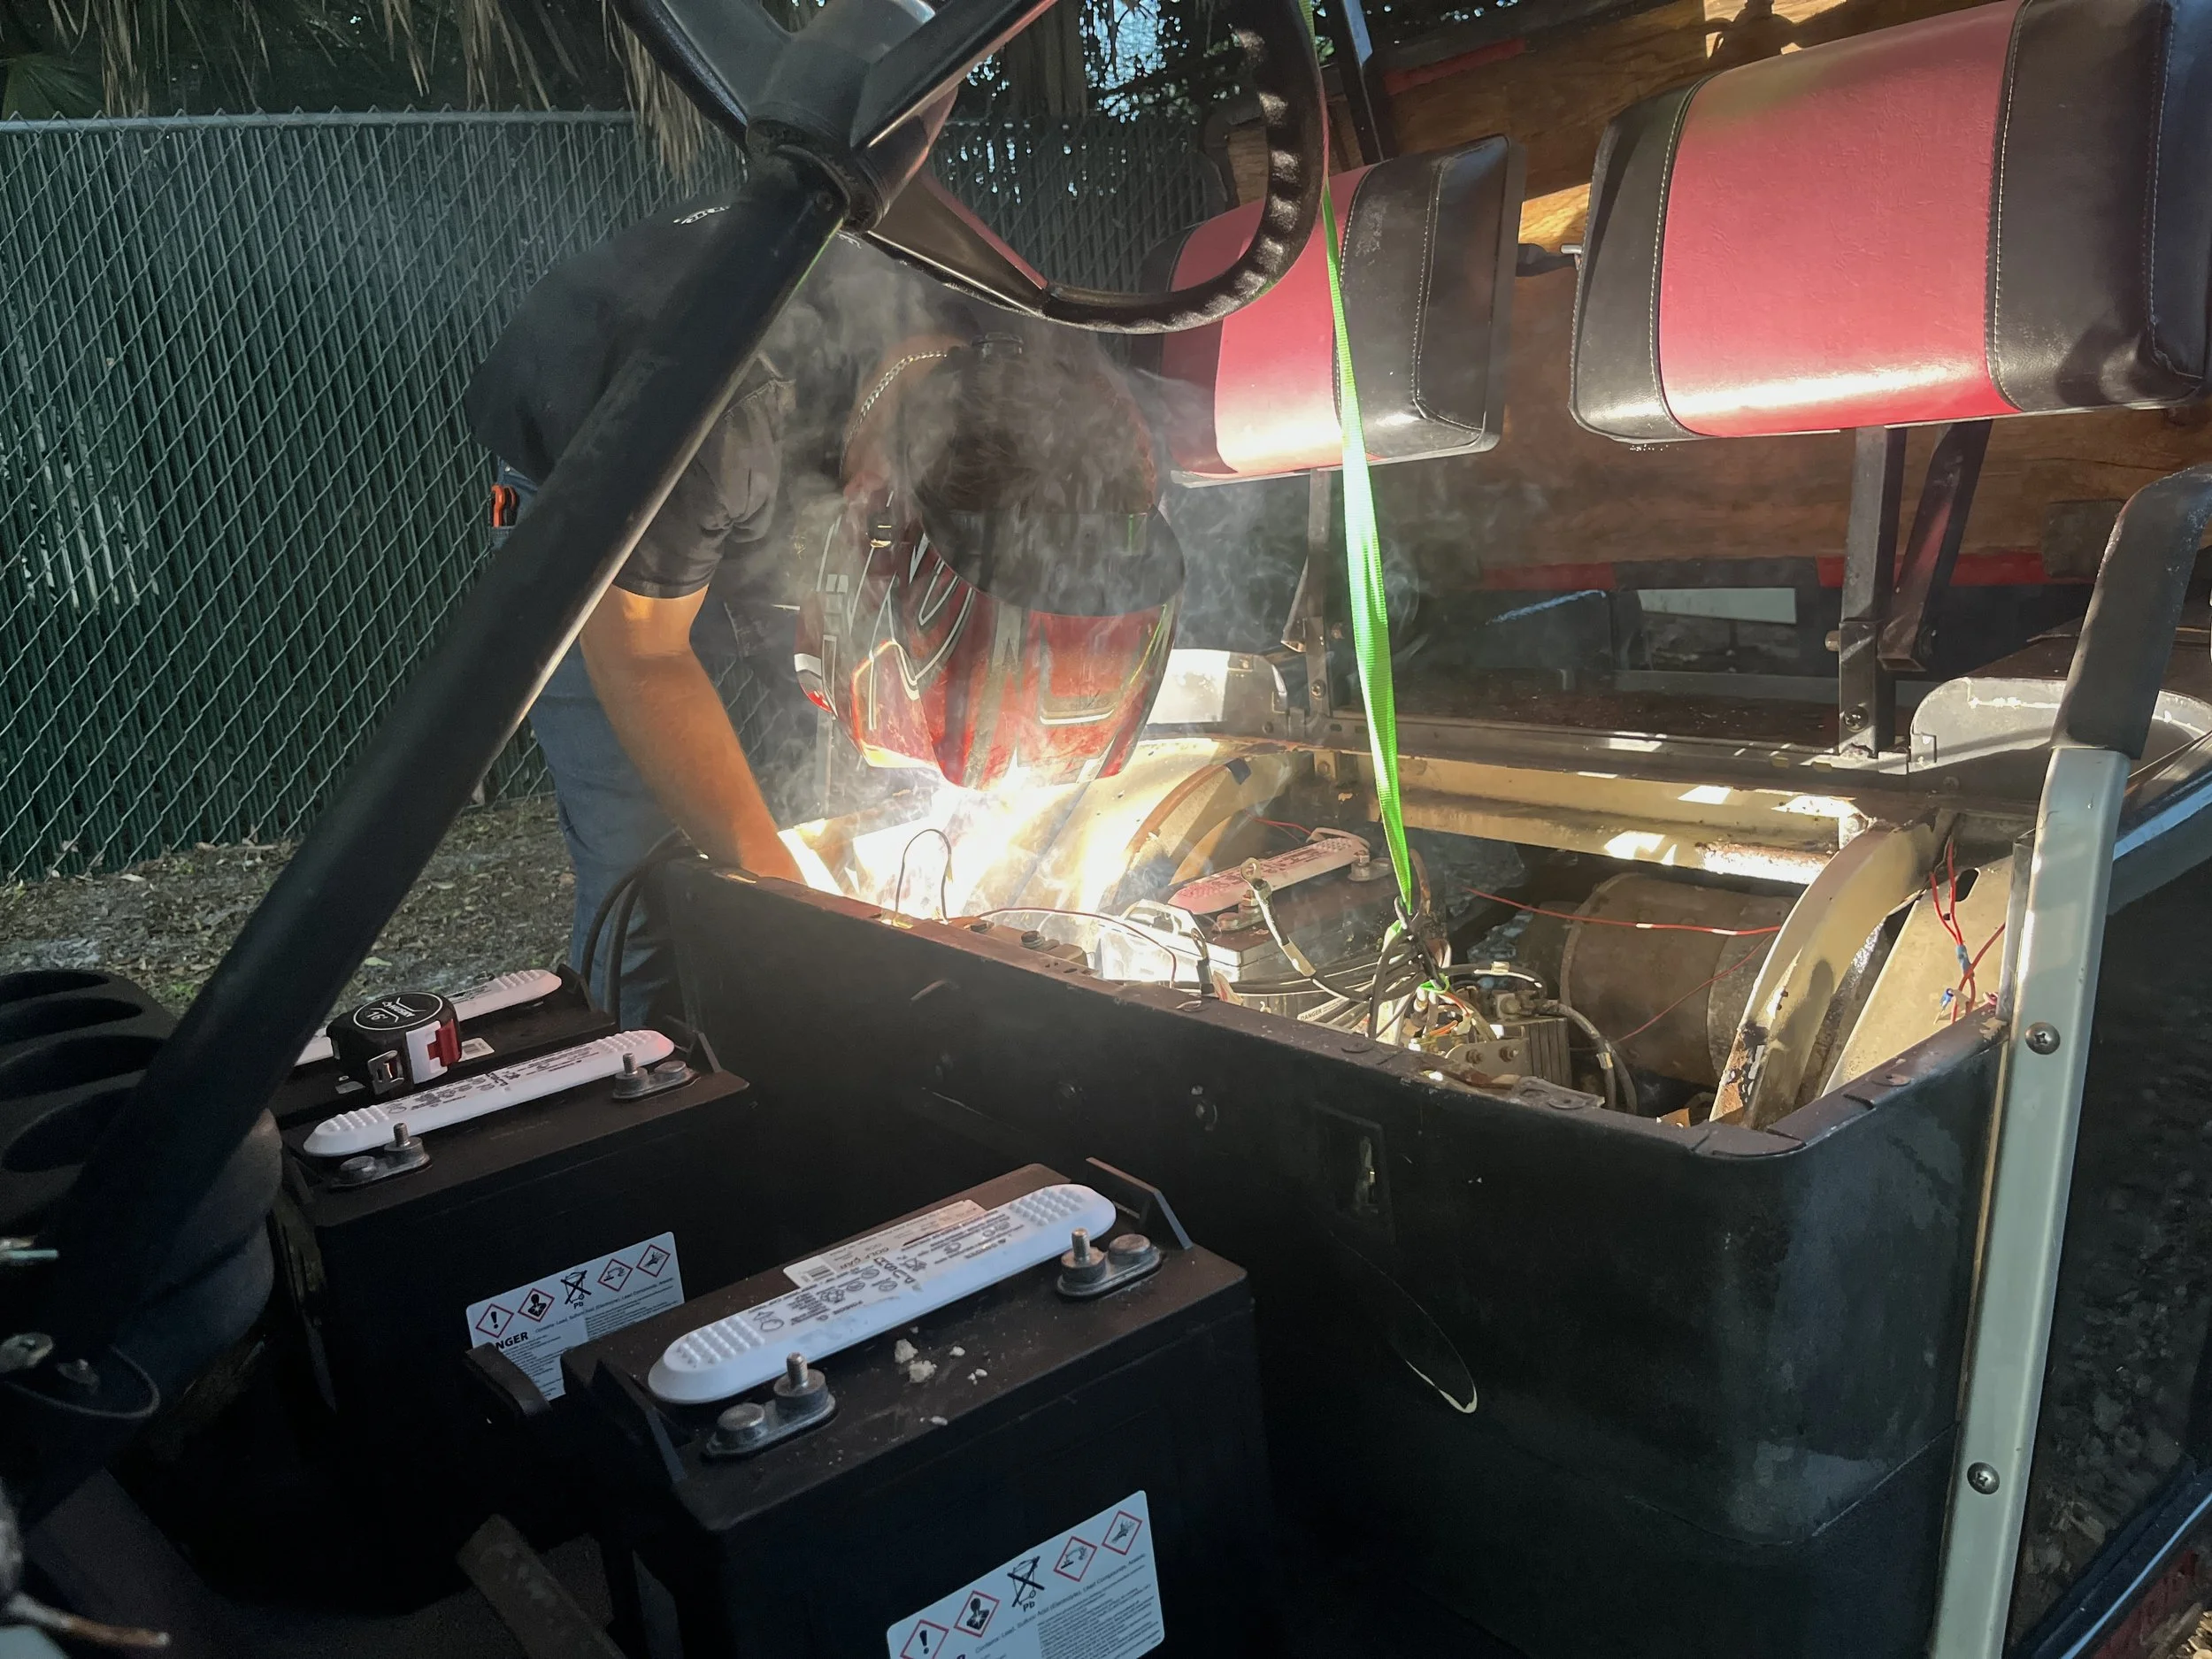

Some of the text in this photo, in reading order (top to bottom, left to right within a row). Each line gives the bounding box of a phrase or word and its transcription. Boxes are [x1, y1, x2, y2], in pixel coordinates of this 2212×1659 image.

[388, 1003, 416, 1018] HUSKY
[1300, 1009, 1323, 1020] DANGER
[495, 1331, 529, 1350] NGER
[1022, 1601, 1035, 1612] Pb
